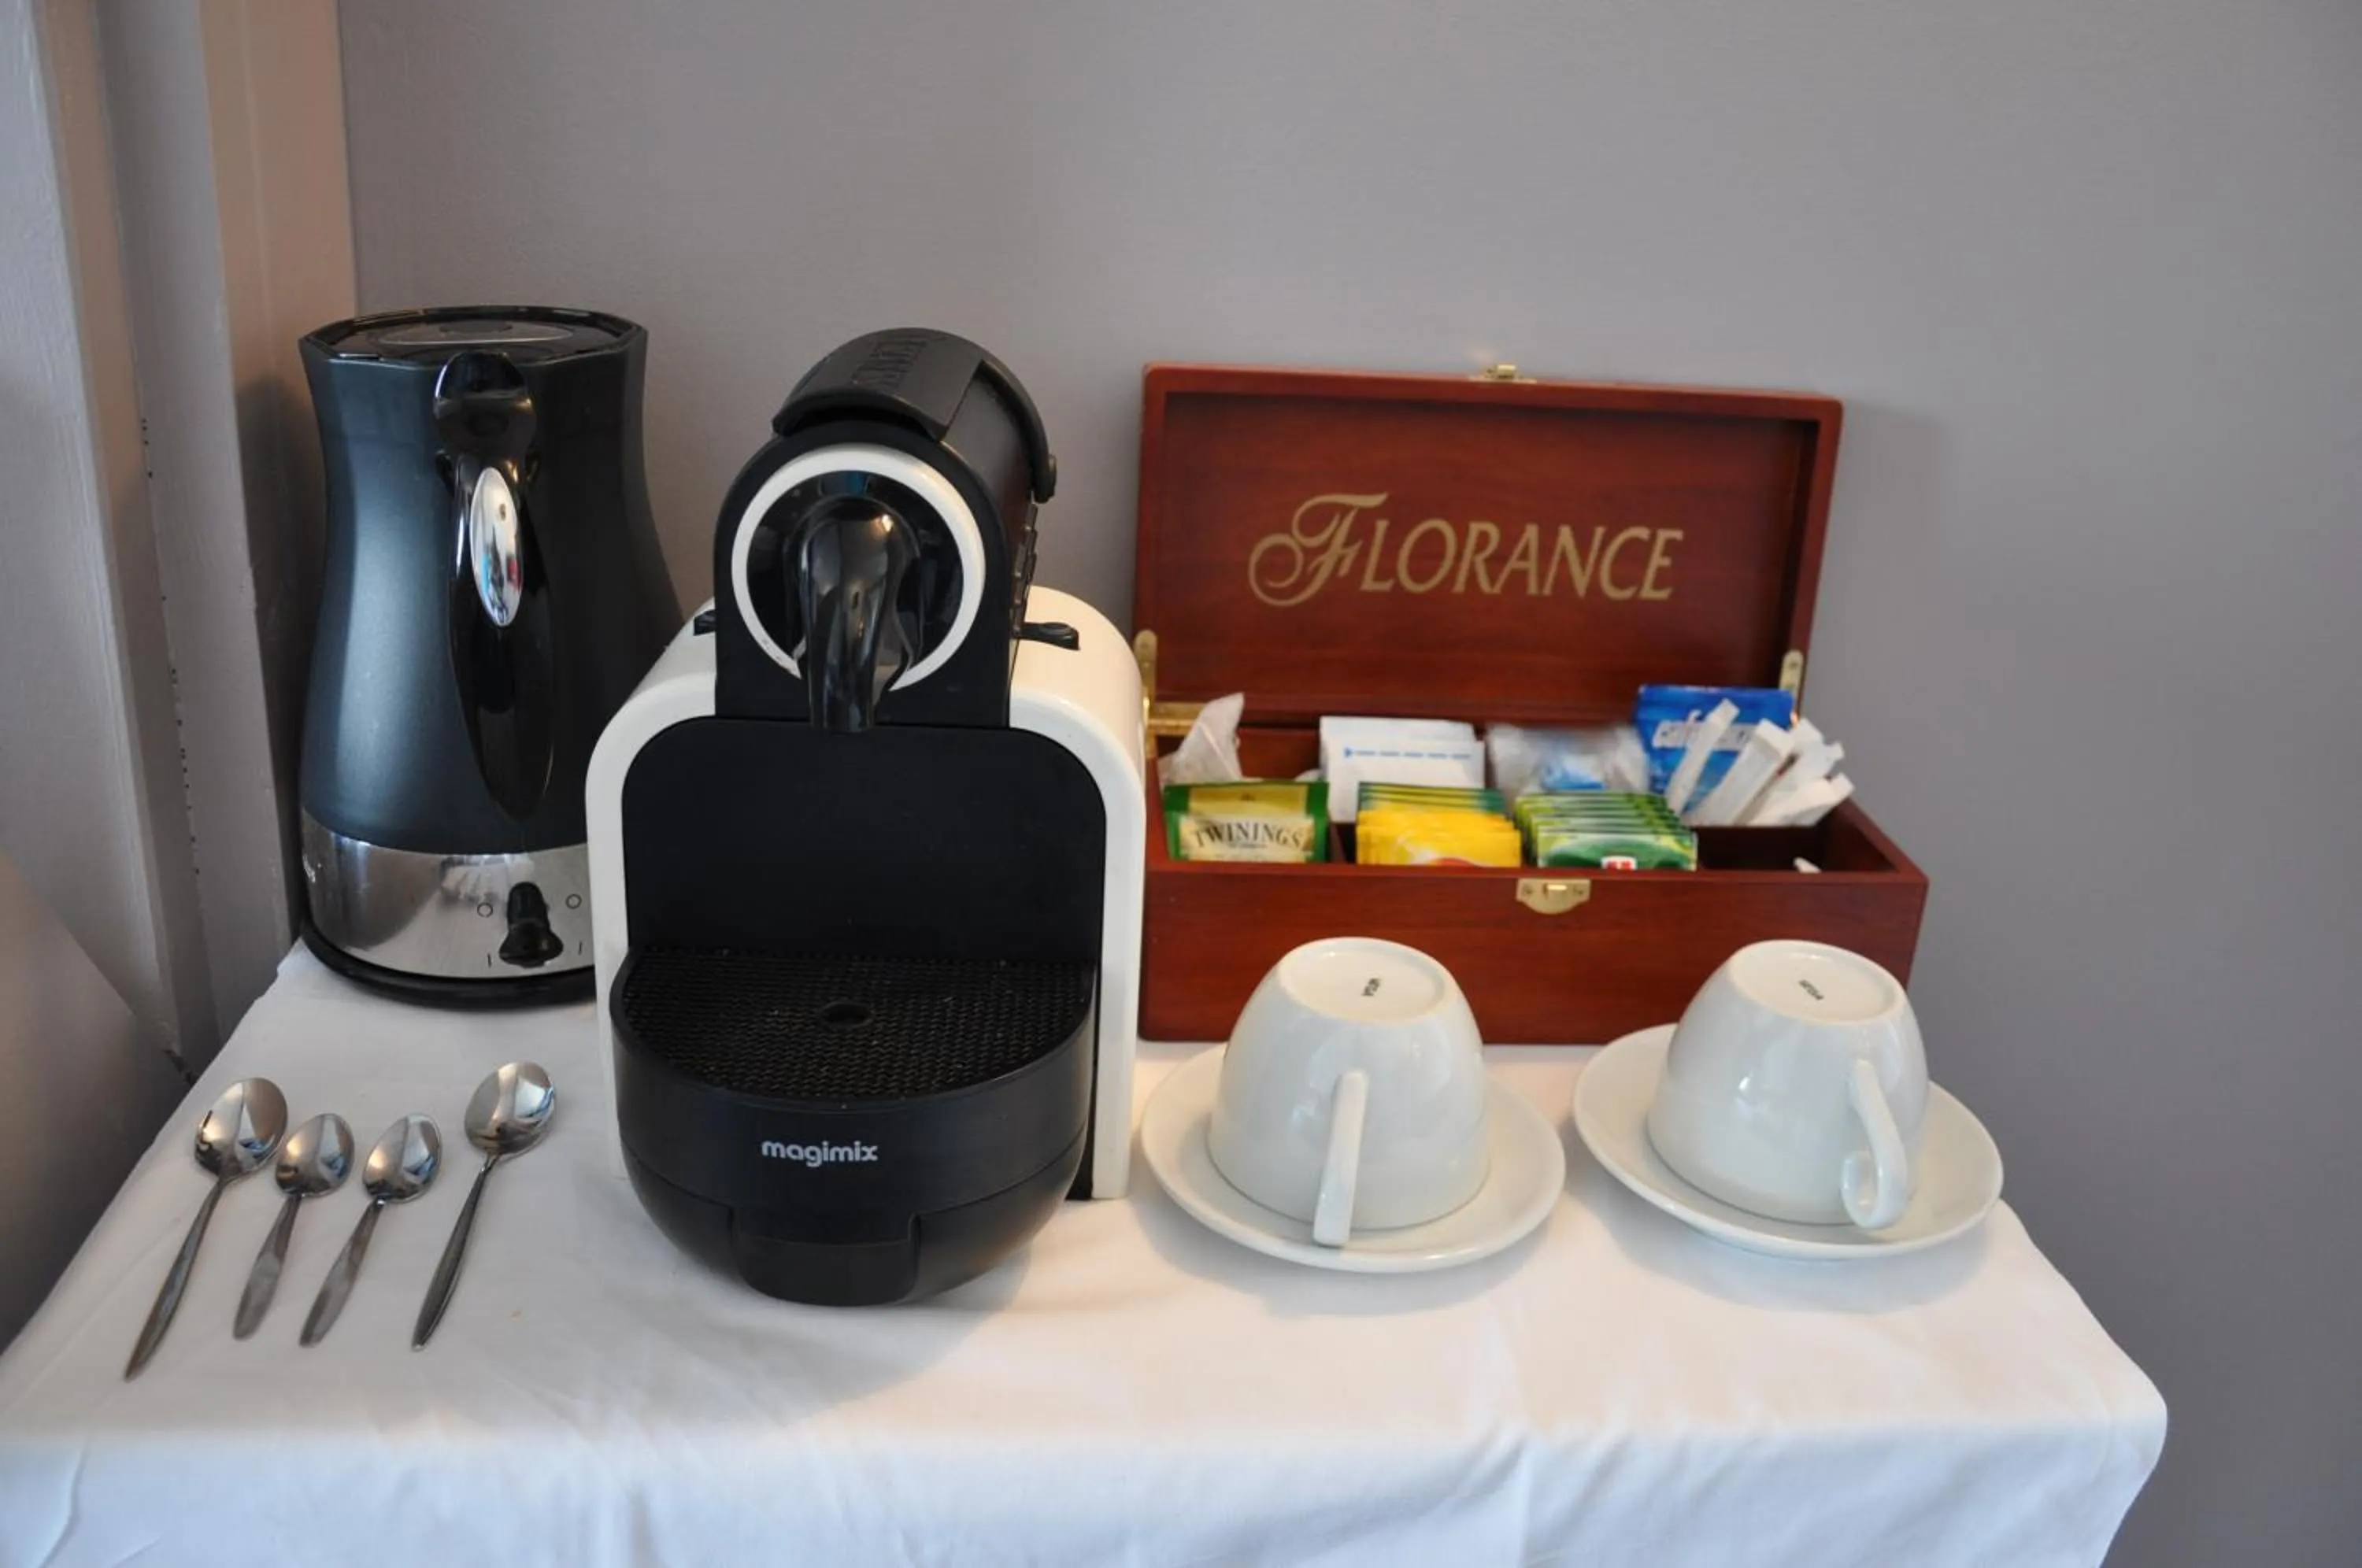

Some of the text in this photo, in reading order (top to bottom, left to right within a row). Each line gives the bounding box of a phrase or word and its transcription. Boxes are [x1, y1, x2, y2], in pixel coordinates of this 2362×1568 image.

[1247, 491, 1684, 606] FLORANCE
[1191, 821, 1304, 849] TWININGS
[761, 1140, 879, 1168] magimix
